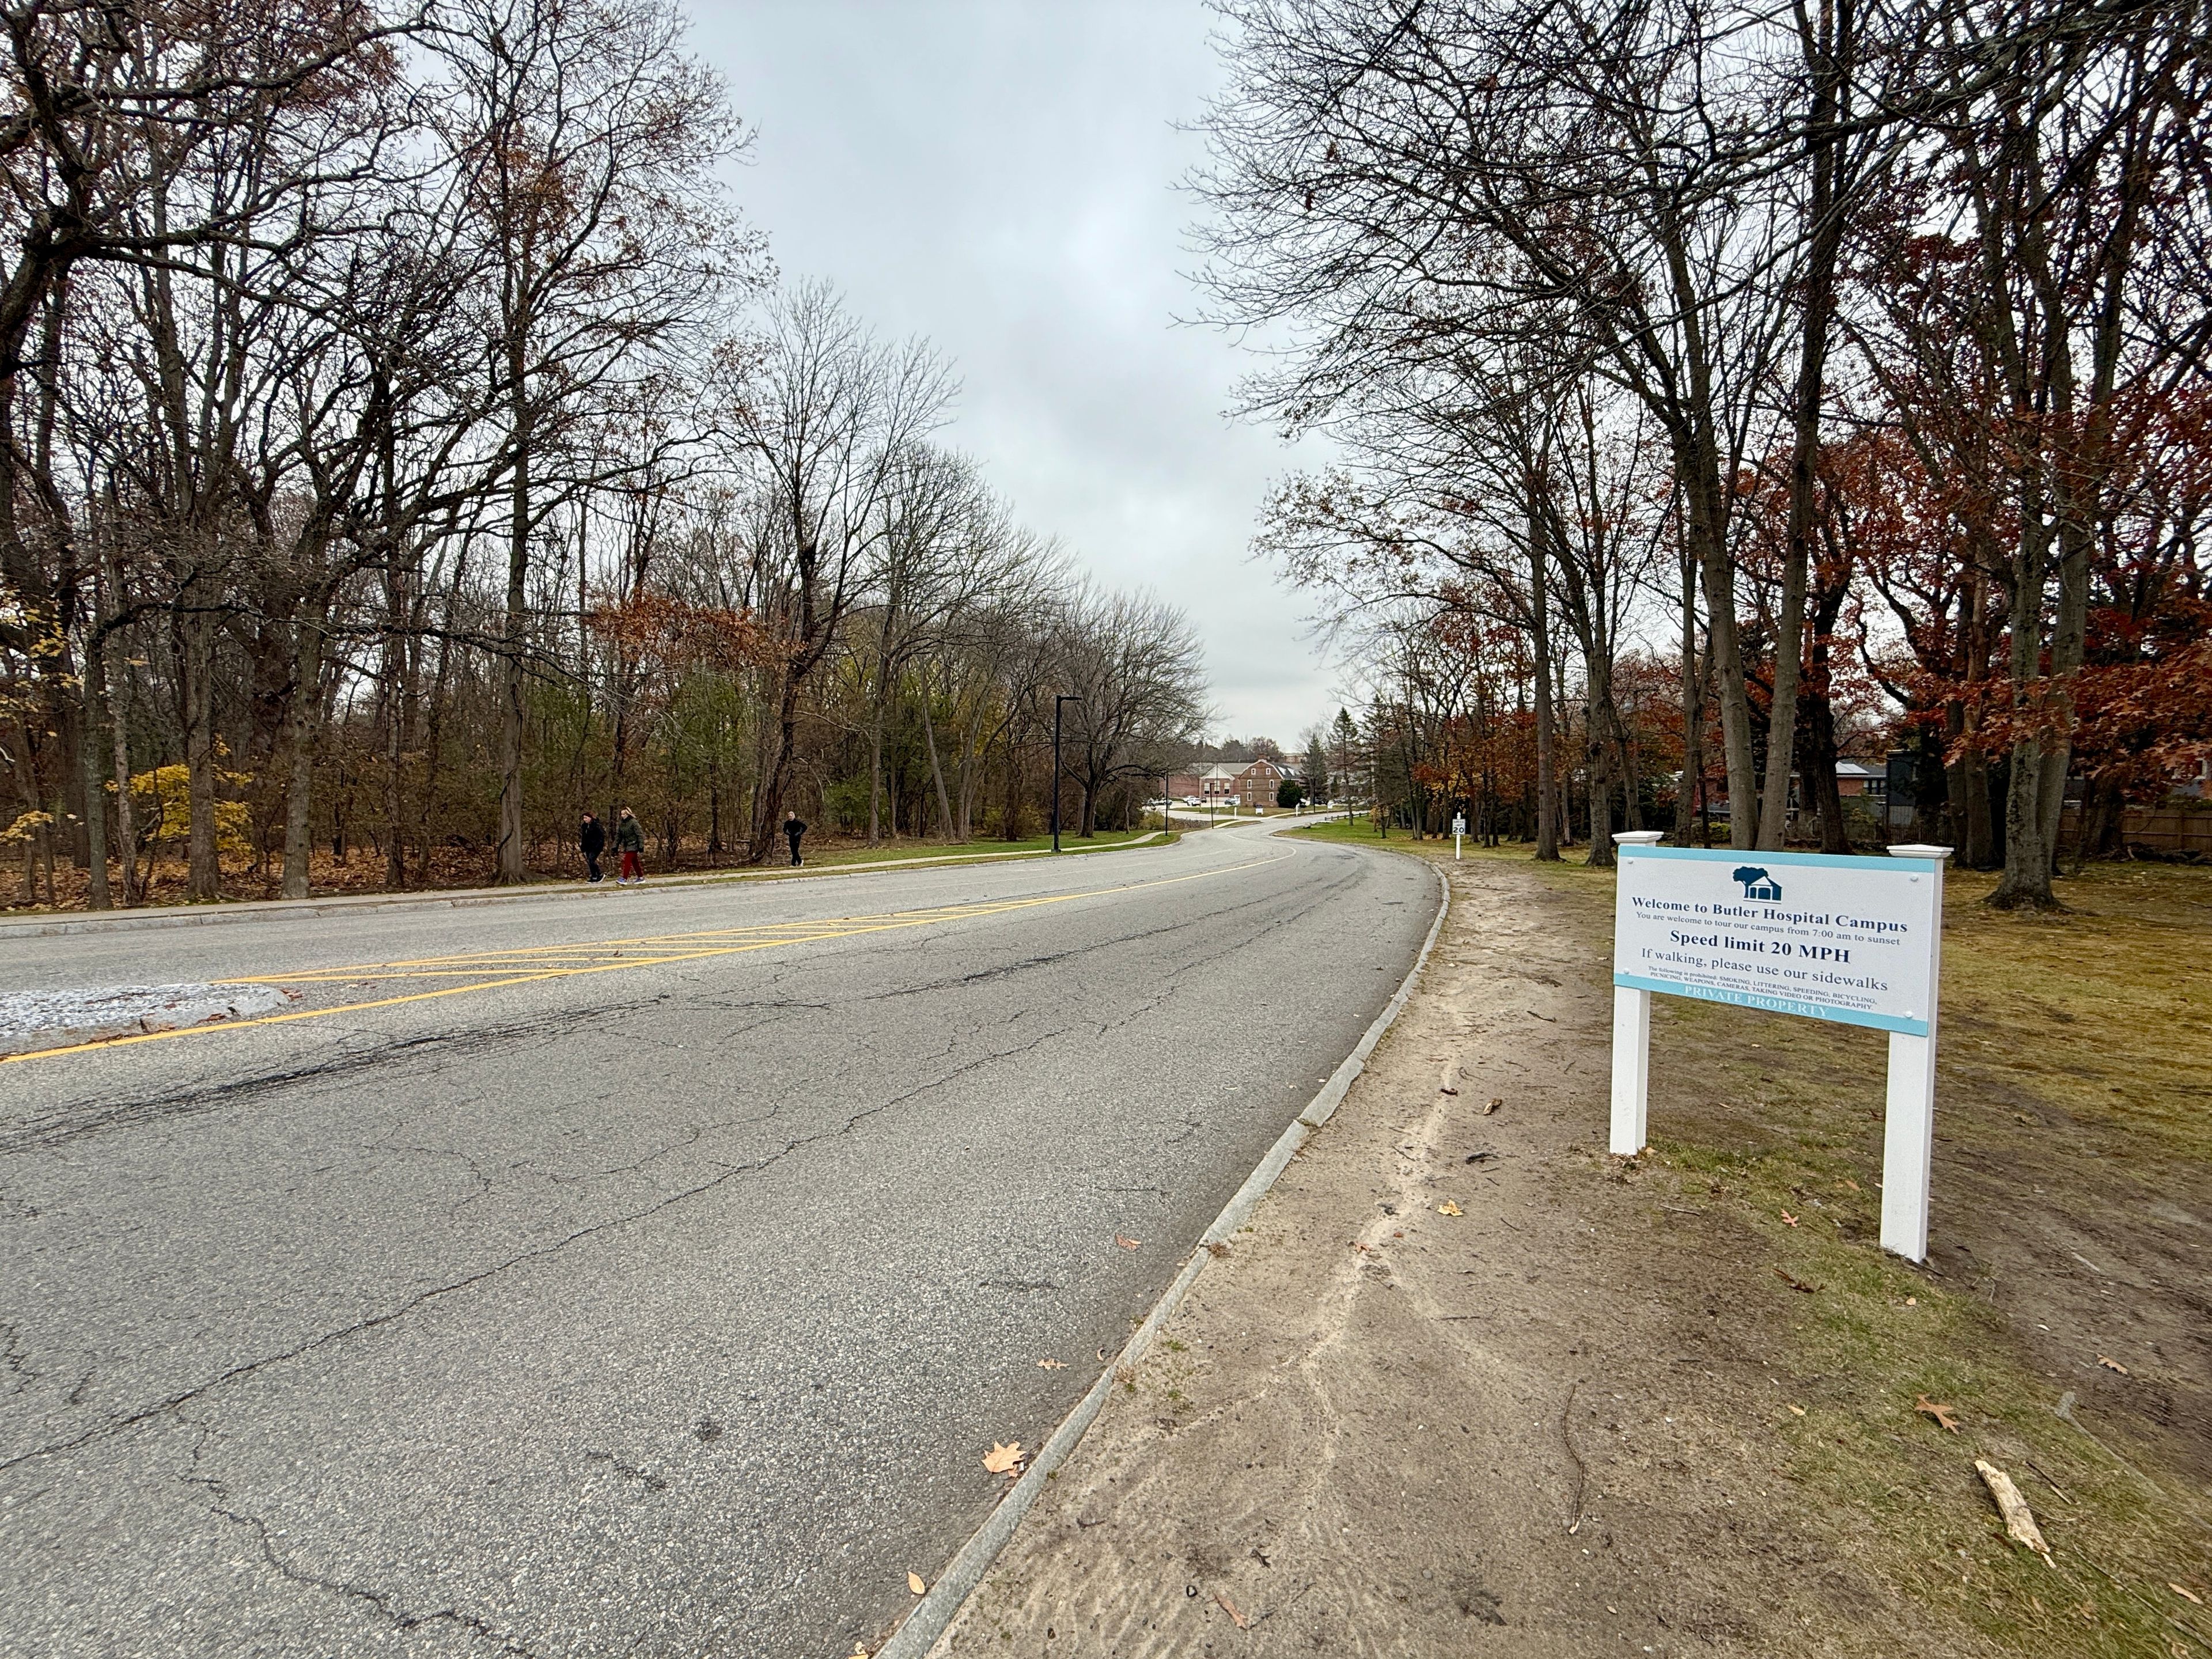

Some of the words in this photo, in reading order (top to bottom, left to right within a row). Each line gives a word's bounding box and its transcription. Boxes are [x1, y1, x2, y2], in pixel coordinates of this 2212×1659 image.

[1632, 897, 1690, 911] Welcome
[1695, 903, 1707, 913] to
[1713, 904, 1758, 917] Butler
[1763, 908, 1830, 925] Hospital
[1835, 915, 1908, 933] Campus
[1637, 911, 1650, 919] You
[1667, 915, 1702, 924] welcome
[1751, 924, 1784, 933] campus
[1787, 927, 1809, 935] from
[1813, 929, 1833, 938] 7:00
[1868, 937, 1900, 945] sunset
[1670, 930, 1718, 946] Speed
[1725, 937, 1765, 952] limit
[1771, 941, 1791, 956] 20
[1799, 945, 1851, 964] MPH
[1642, 948, 1653, 958] If
[1655, 952, 1707, 967] walking,
[1711, 958, 1752, 971] please
[1757, 965, 1779, 975] use
[1784, 969, 1808, 979] our
[1812, 971, 1888, 991] sidewalks
[1658, 968, 1683, 976] following
[1719, 976, 1752, 986] SMOKING,
[1753, 981, 1791, 991] LITTERING,
[1793, 987, 1830, 997] SPEEDING,
[1833, 993, 1877, 1005] BICYCLING,
[1684, 976, 1715, 986] WEAPONS,
[1717, 982, 1751, 991] CAMERAS,
[1752, 987, 1778, 995] TAKING
[1779, 991, 1802, 999] VIDEO
[1685, 985, 1743, 1002] PRIVATE
[1747, 995, 1828, 1017] PROPERTY
